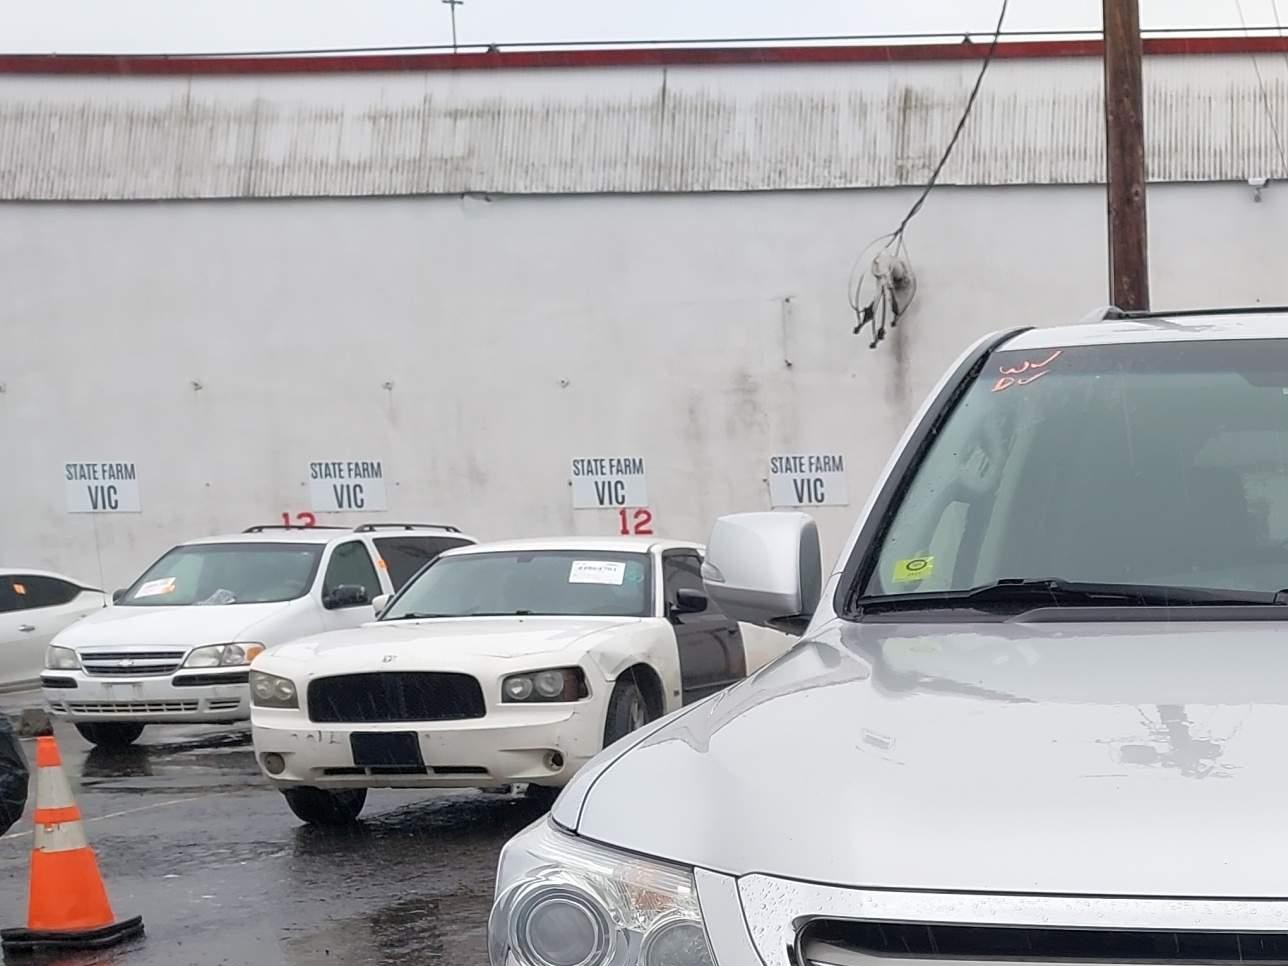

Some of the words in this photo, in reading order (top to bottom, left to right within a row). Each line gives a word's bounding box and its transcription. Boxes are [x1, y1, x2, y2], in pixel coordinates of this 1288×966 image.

[65, 463, 99, 481] STATE
[101, 463, 136, 481] FARM
[310, 462, 344, 479] STATE
[347, 461, 383, 479] FARM
[572, 458, 607, 476] STATE
[609, 457, 644, 475] FARM
[771, 456, 806, 474] STATE
[808, 455, 844, 473] FARM
[87, 485, 119, 510] VIC
[333, 483, 365, 509] VIC
[594, 480, 626, 506] VIC
[793, 478, 825, 504] VIC
[619, 508, 654, 535] 12
